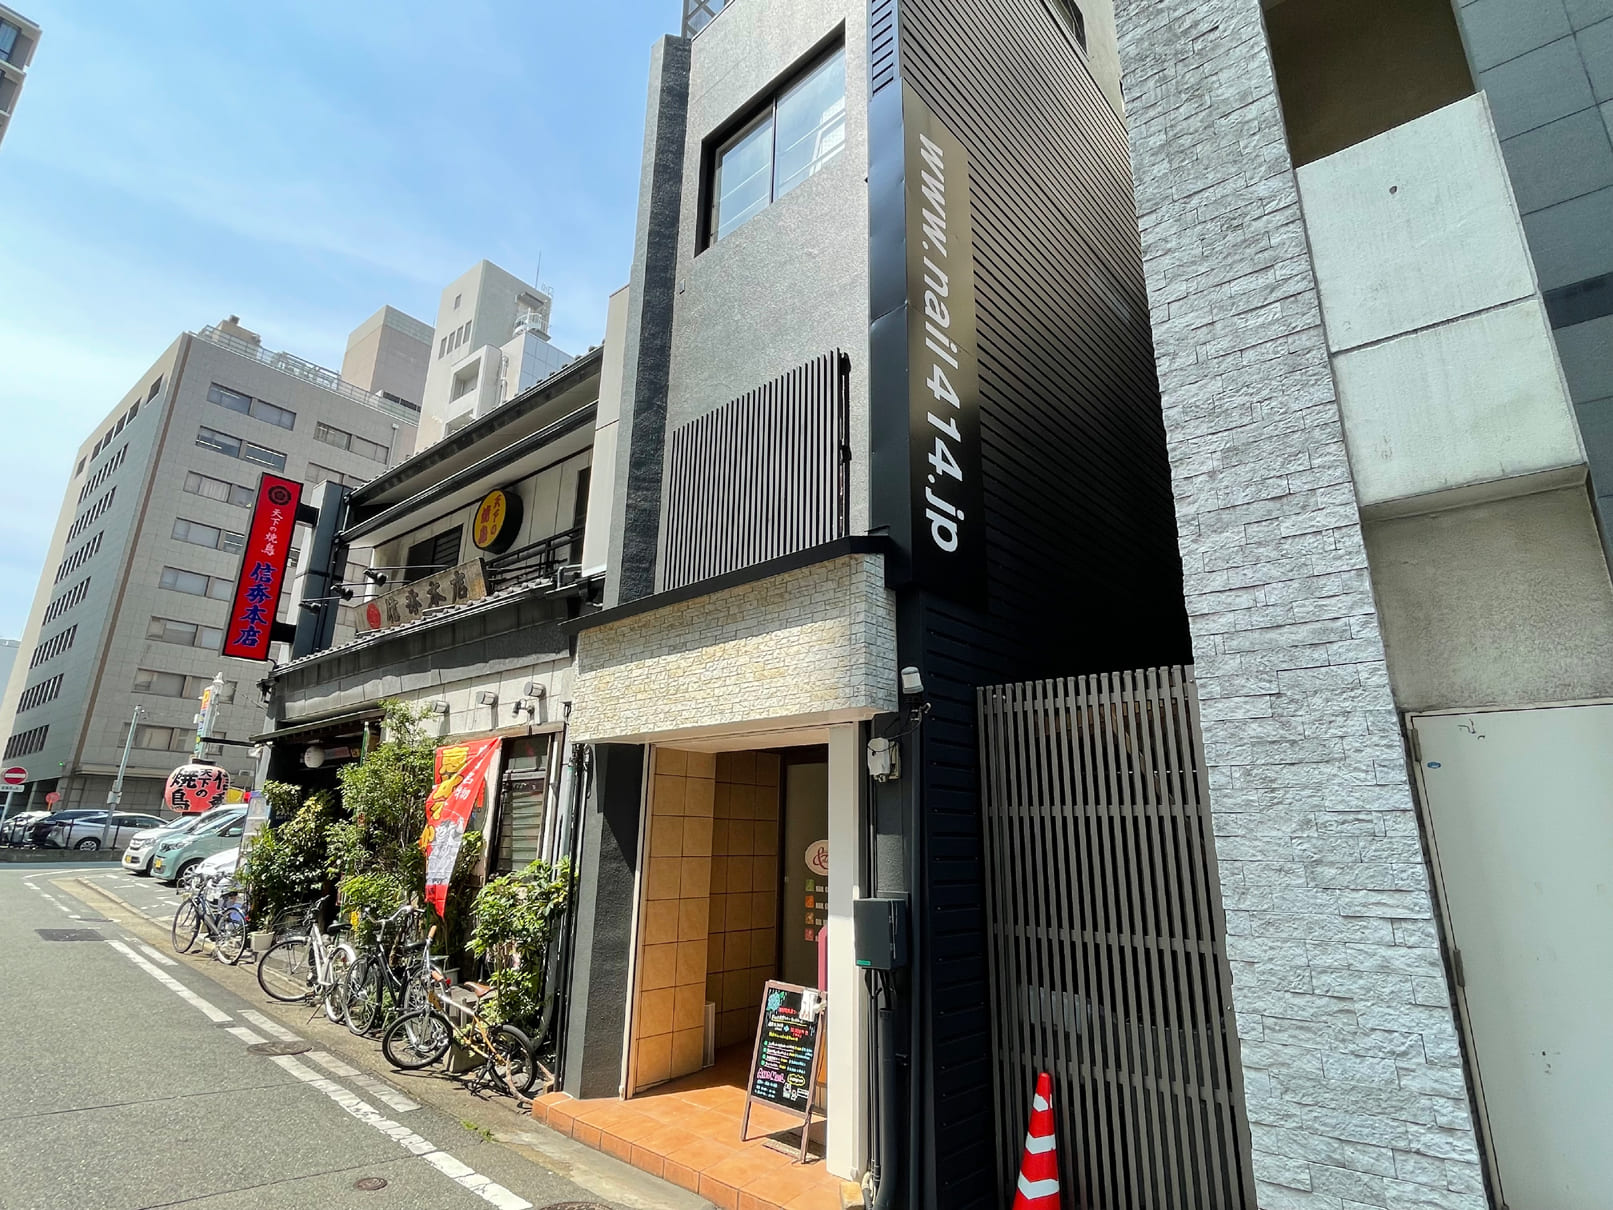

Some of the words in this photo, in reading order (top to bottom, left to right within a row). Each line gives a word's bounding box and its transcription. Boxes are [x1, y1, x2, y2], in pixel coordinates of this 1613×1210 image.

[919, 133, 965, 553] www.nail414.jp
[232, 560, 277, 648] 信秀本店
[169, 770, 199, 811] 焼鳥
[195, 768, 214, 798] 天下の
